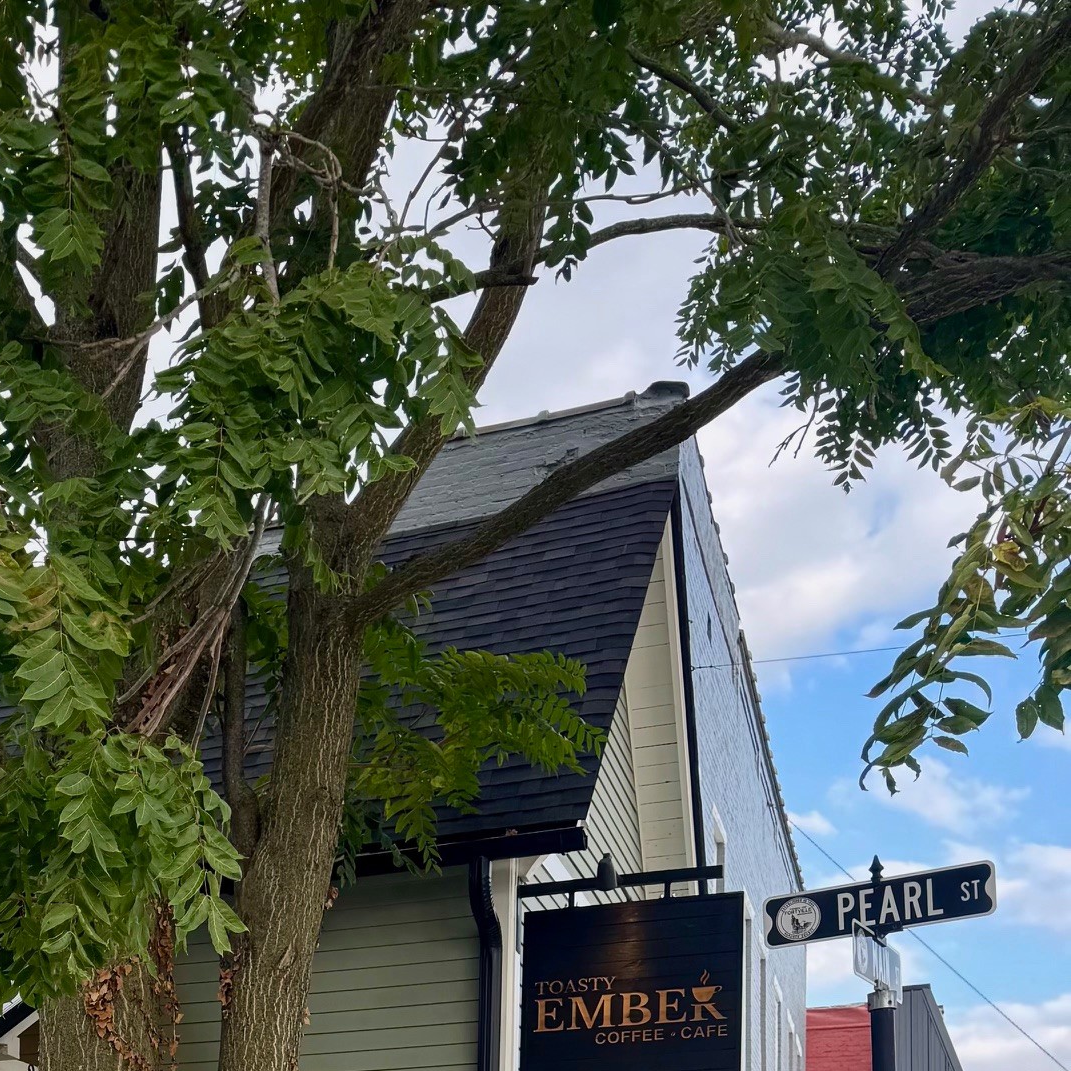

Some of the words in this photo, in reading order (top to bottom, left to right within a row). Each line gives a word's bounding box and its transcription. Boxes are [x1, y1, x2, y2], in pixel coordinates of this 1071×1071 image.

[837, 878, 944, 931] PEARL
[960, 879, 980, 902] ST
[534, 976, 616, 996] TOASTY
[533, 985, 728, 1033] EMBER
[595, 1028, 665, 1045] COFFEE
[680, 1024, 728, 1040] CAFE
